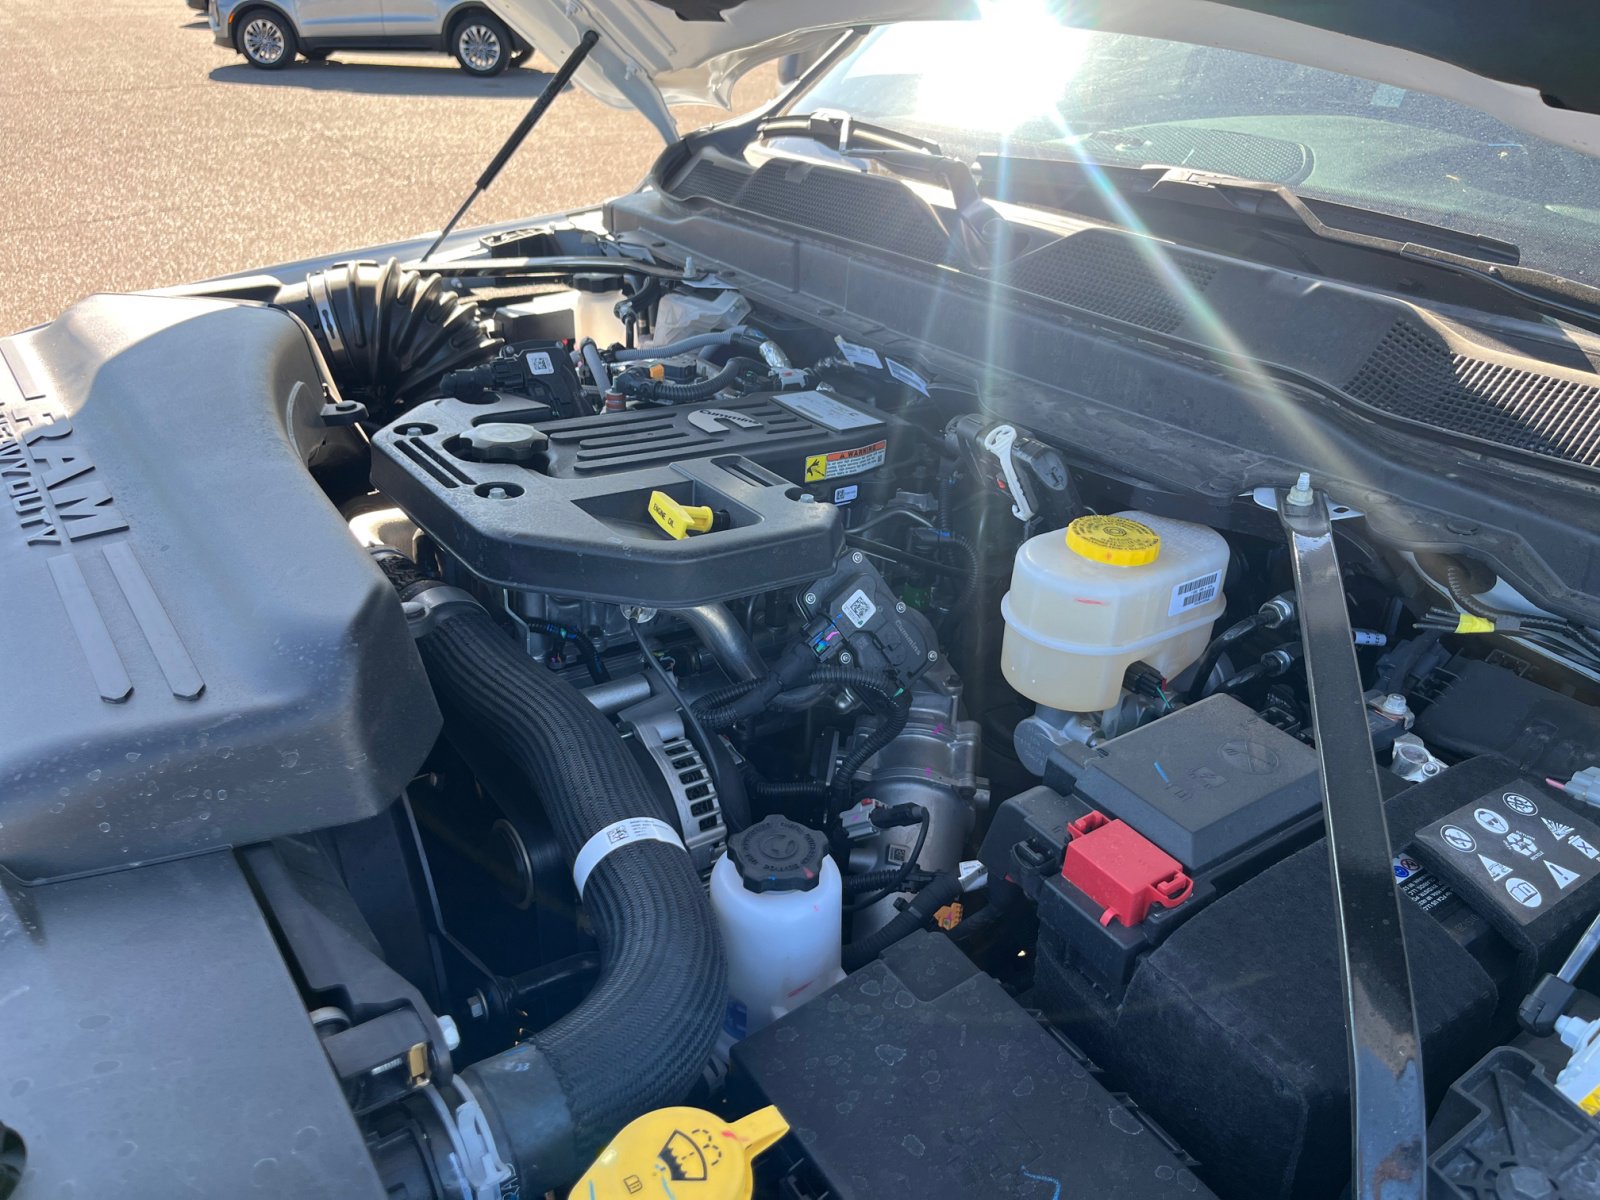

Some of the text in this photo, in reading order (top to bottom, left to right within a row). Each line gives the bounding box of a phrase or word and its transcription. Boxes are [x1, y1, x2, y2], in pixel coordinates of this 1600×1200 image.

[847, 445, 877, 457] WARNING
[11, 406, 130, 543] RAM
[6, 476, 62, 547] DUTY
[653, 503, 675, 529] ENGINE OIL
[895, 619, 922, 657] Cummins
